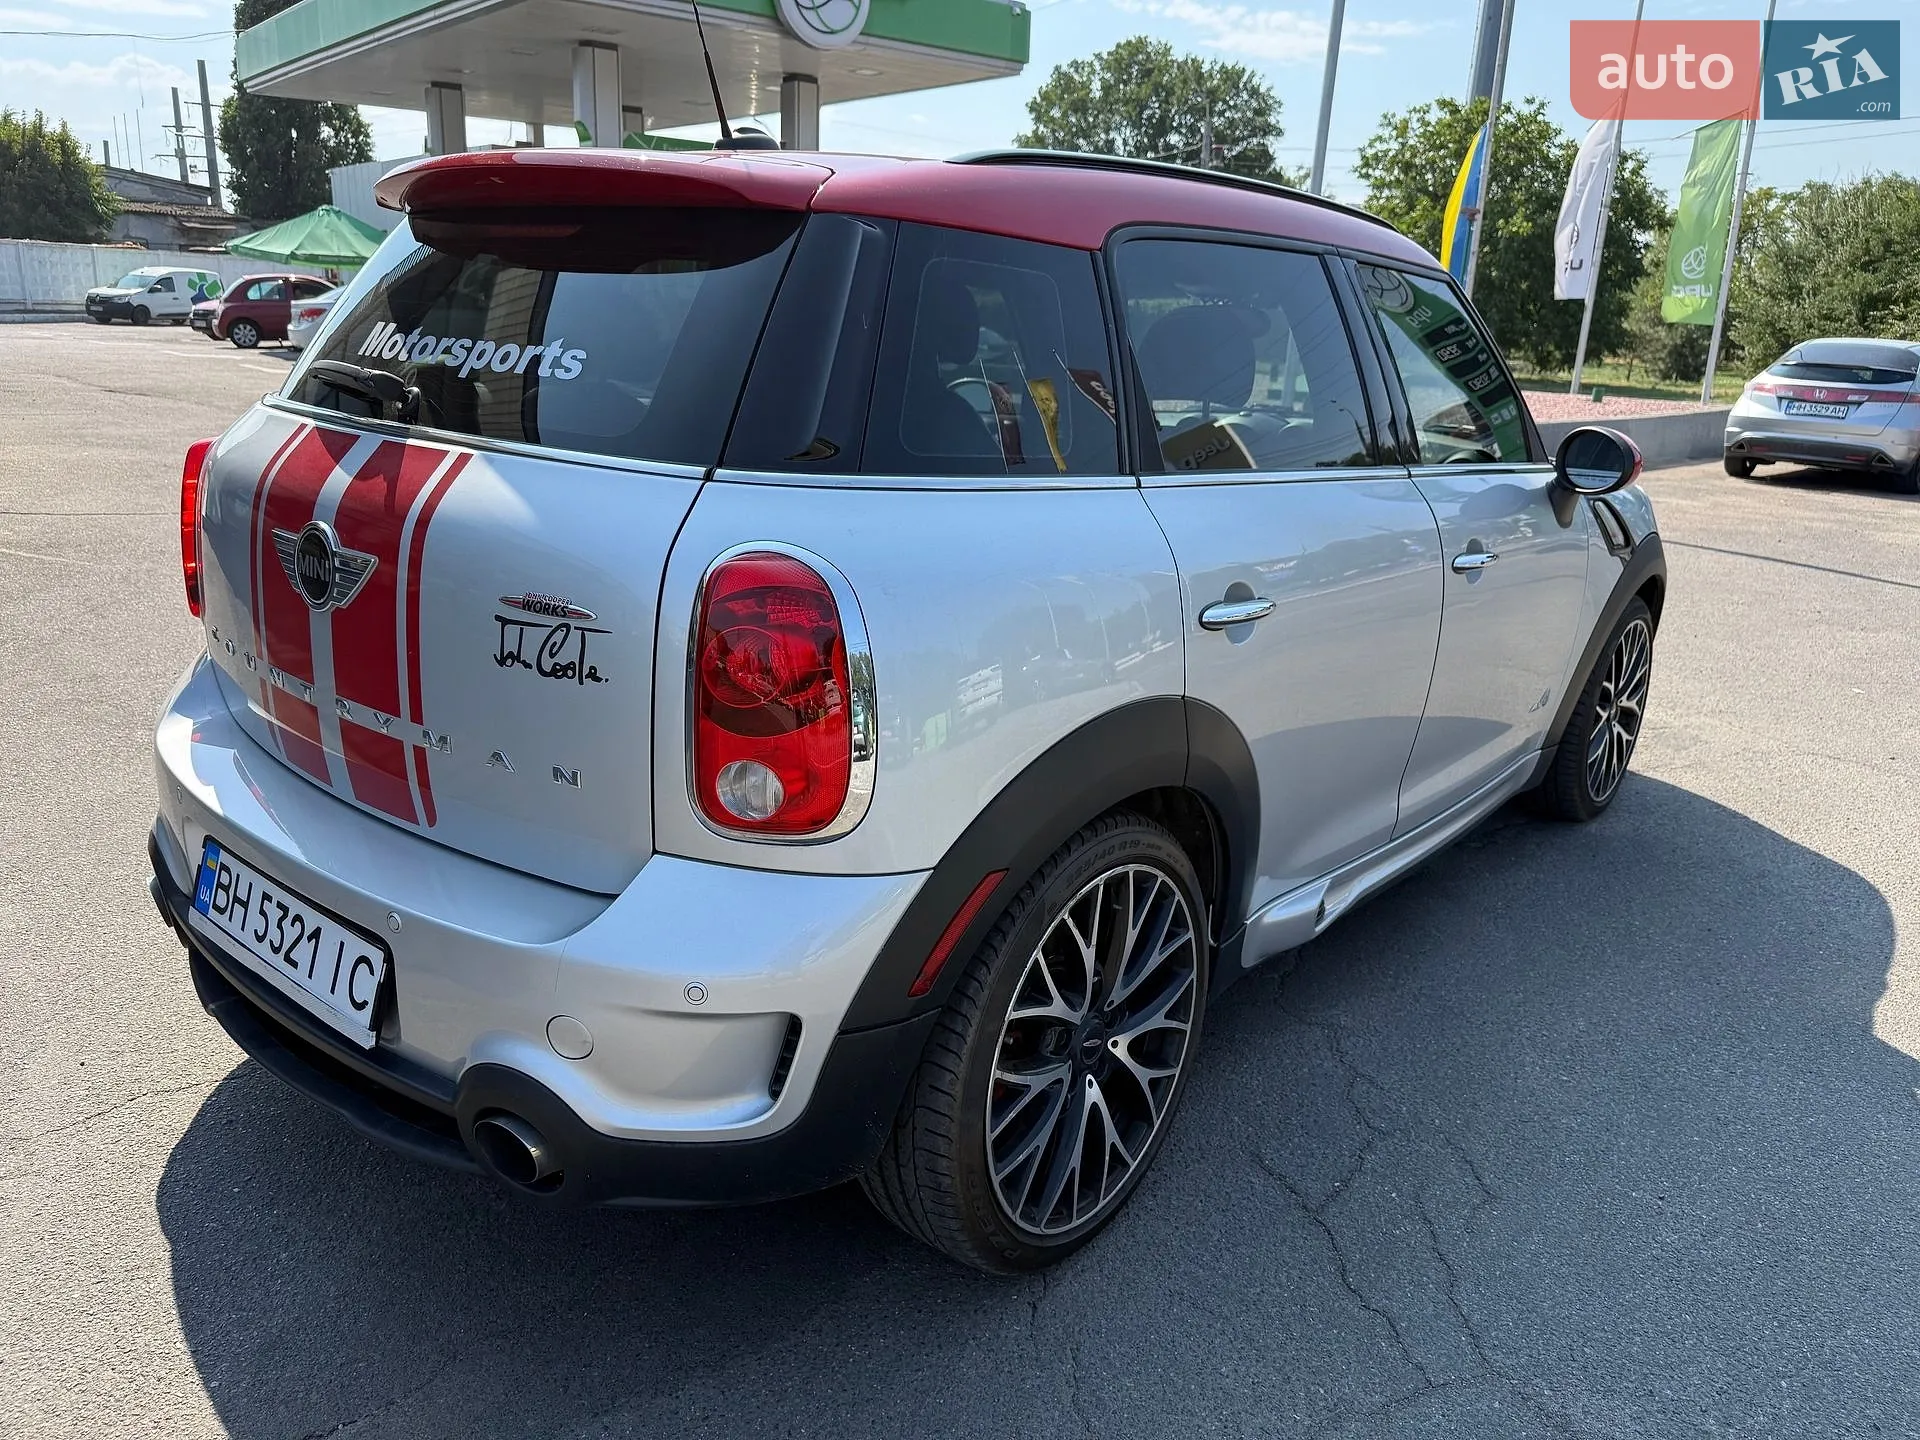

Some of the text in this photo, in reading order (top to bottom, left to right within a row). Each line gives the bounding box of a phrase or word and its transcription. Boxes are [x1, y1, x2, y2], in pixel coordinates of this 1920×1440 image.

[357, 321, 588, 381] Motorsports
[298, 552, 330, 582] MINI
[522, 598, 568, 618] WORKS
[211, 625, 583, 789] COUNTRYMAN
[200, 884, 210, 906] UA
[211, 861, 375, 1011] BH 5321 IC
